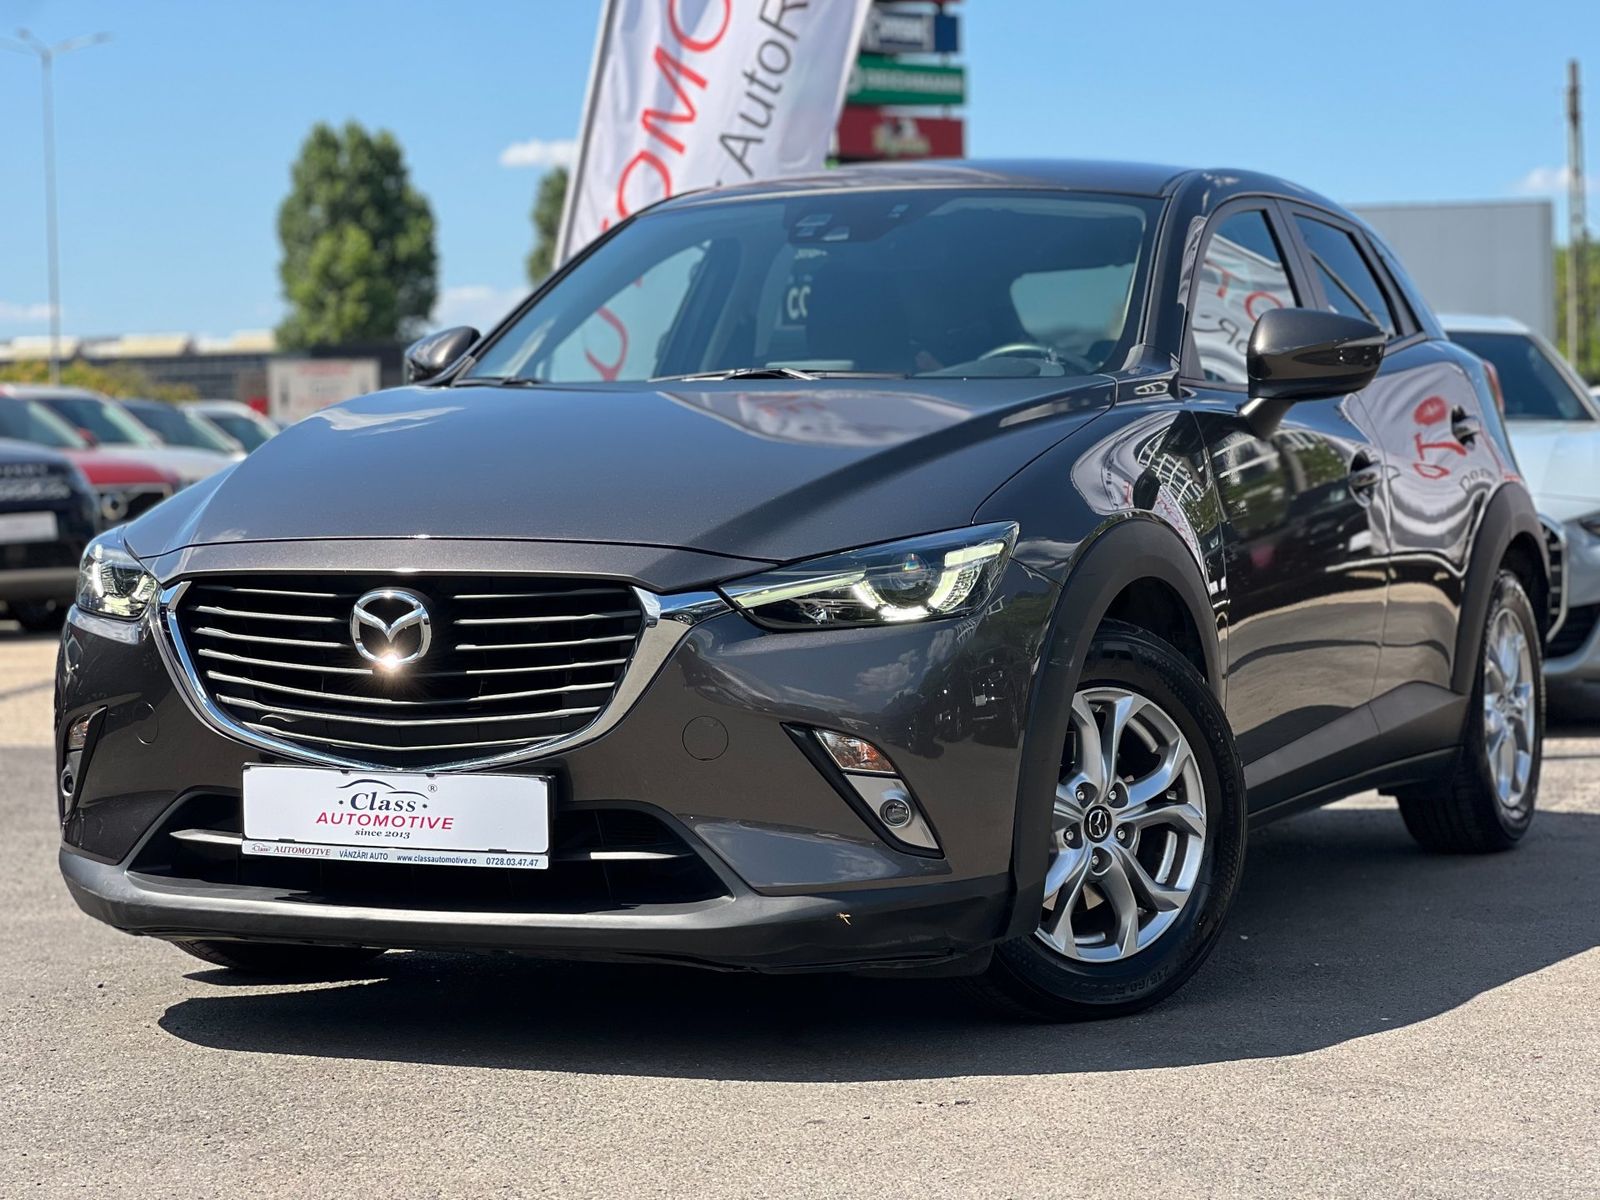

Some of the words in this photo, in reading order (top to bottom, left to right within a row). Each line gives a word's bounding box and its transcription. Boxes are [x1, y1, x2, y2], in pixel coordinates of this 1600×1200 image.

[350, 791, 417, 812] Class
[316, 812, 454, 830] AUTOMOTIVE
[354, 828, 382, 838] since
[384, 830, 411, 840] 2013
[274, 845, 331, 857] AUTOMOTIVE
[369, 852, 389, 861] AUTO
[396, 854, 477, 865] www.classautomotive.ro
[485, 857, 539, 867] 0728.03.47.47
